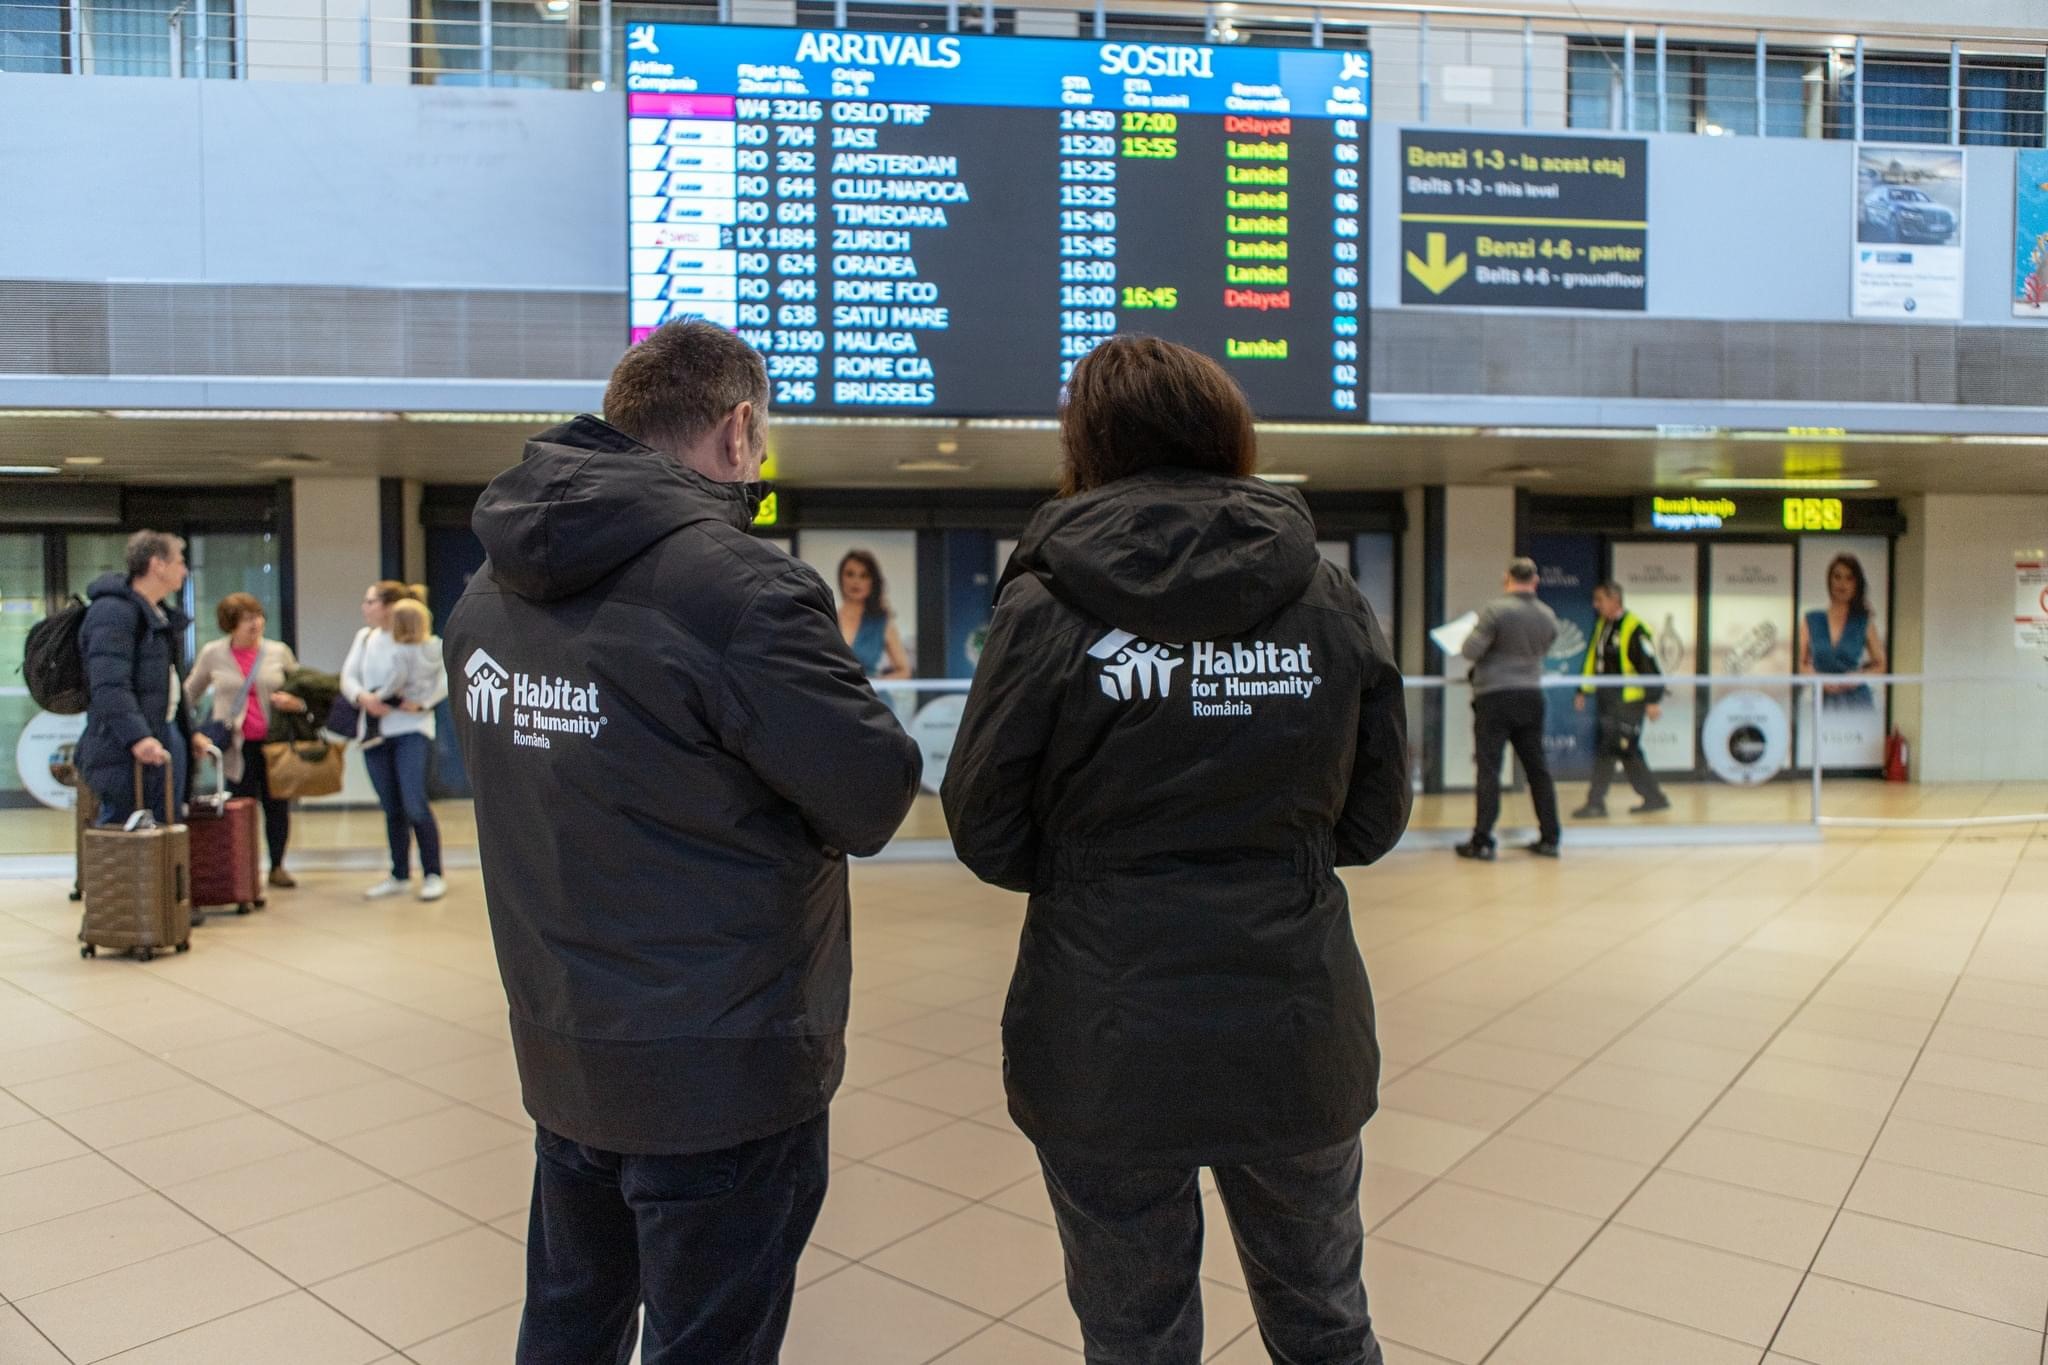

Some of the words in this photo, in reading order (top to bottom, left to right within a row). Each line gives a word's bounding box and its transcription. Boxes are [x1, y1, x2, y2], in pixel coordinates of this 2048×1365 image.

[795, 32, 961, 68] ARRIVALS
[1100, 44, 1213, 78] SOSIRI
[736, 99, 769, 119] W4
[772, 99, 822, 121] 3216
[831, 101, 889, 123] OSLO
[889, 104, 931, 124] TRF
[1059, 110, 1116, 131] 14:50
[1122, 111, 1177, 133] 17:00
[1224, 115, 1291, 136] Delayed
[737, 124, 768, 146] RO
[776, 125, 816, 147] 704
[831, 127, 877, 148] IASI
[1060, 135, 1116, 157] 15:20
[1122, 137, 1177, 159] 15:55
[1226, 140, 1288, 161] Landed
[737, 150, 768, 172] RO
[776, 151, 816, 173] 362
[831, 153, 957, 176] AMSTERDAM
[1060, 160, 1116, 182] 15:25
[1226, 165, 1288, 186] Landed
[1407, 146, 1467, 168] Benzi
[1472, 149, 1505, 170] 1-3
[1520, 153, 1539, 171] la
[1541, 157, 1590, 173] acest
[1592, 157, 1625, 179] etaj
[738, 175, 768, 197] RO
[776, 176, 816, 198] 644
[832, 179, 969, 203] CLUJ-NAPOCA
[1060, 185, 1116, 207] 15:25
[1226, 190, 1288, 211] Landed
[1407, 175, 1452, 194] Belts
[1455, 177, 1482, 196] 1-3
[1494, 181, 1523, 197] this
[1523, 182, 1559, 199] level
[738, 201, 768, 223] RO
[777, 202, 816, 224] 604
[832, 204, 947, 227] TIMISOARA
[1060, 210, 1116, 232] 15:40
[1226, 214, 1288, 235] Landed
[737, 227, 765, 248] LX
[767, 228, 816, 249] 1884
[832, 230, 910, 251] ZURICH
[1060, 235, 1116, 257] 15:45
[1226, 240, 1288, 260] Landed
[1475, 236, 1535, 258] Benzi
[1539, 239, 1573, 260] 4-6
[1588, 245, 1642, 264] parter
[738, 252, 769, 274] RO
[777, 254, 816, 275] 624
[832, 255, 917, 277] ORADEA
[1060, 260, 1116, 283] 16:00
[1226, 264, 1288, 285] Landed
[1475, 265, 1520, 284] Belts
[1523, 267, 1550, 286] 4-6
[1561, 272, 1644, 290] groundfloor
[738, 278, 769, 300] RO
[777, 279, 817, 301] 404
[833, 281, 894, 302] ROME
[895, 282, 938, 303] FCO
[1060, 285, 1116, 308] 16:00
[1122, 287, 1177, 310] 16:45
[1224, 288, 1290, 311] Delayed
[738, 303, 769, 325] RO
[777, 304, 817, 326] 638
[833, 306, 889, 328] SATU
[891, 308, 949, 330] MARE
[1060, 310, 1116, 333] 16:10
[774, 330, 824, 353] 3190
[834, 331, 917, 353] MALAGA
[1226, 337, 1288, 359] Landed
[768, 355, 818, 378] 3958
[834, 357, 894, 380] ROME
[895, 358, 934, 380] CIA
[776, 381, 816, 404] 246
[834, 383, 935, 406] BRUSSELS
[1192, 640, 1312, 675] Habitat
[513, 673, 600, 713] Habitat
[1191, 677, 1220, 697] for
[514, 708, 530, 727] for
[1193, 701, 1252, 716] România
[514, 730, 551, 749] România
